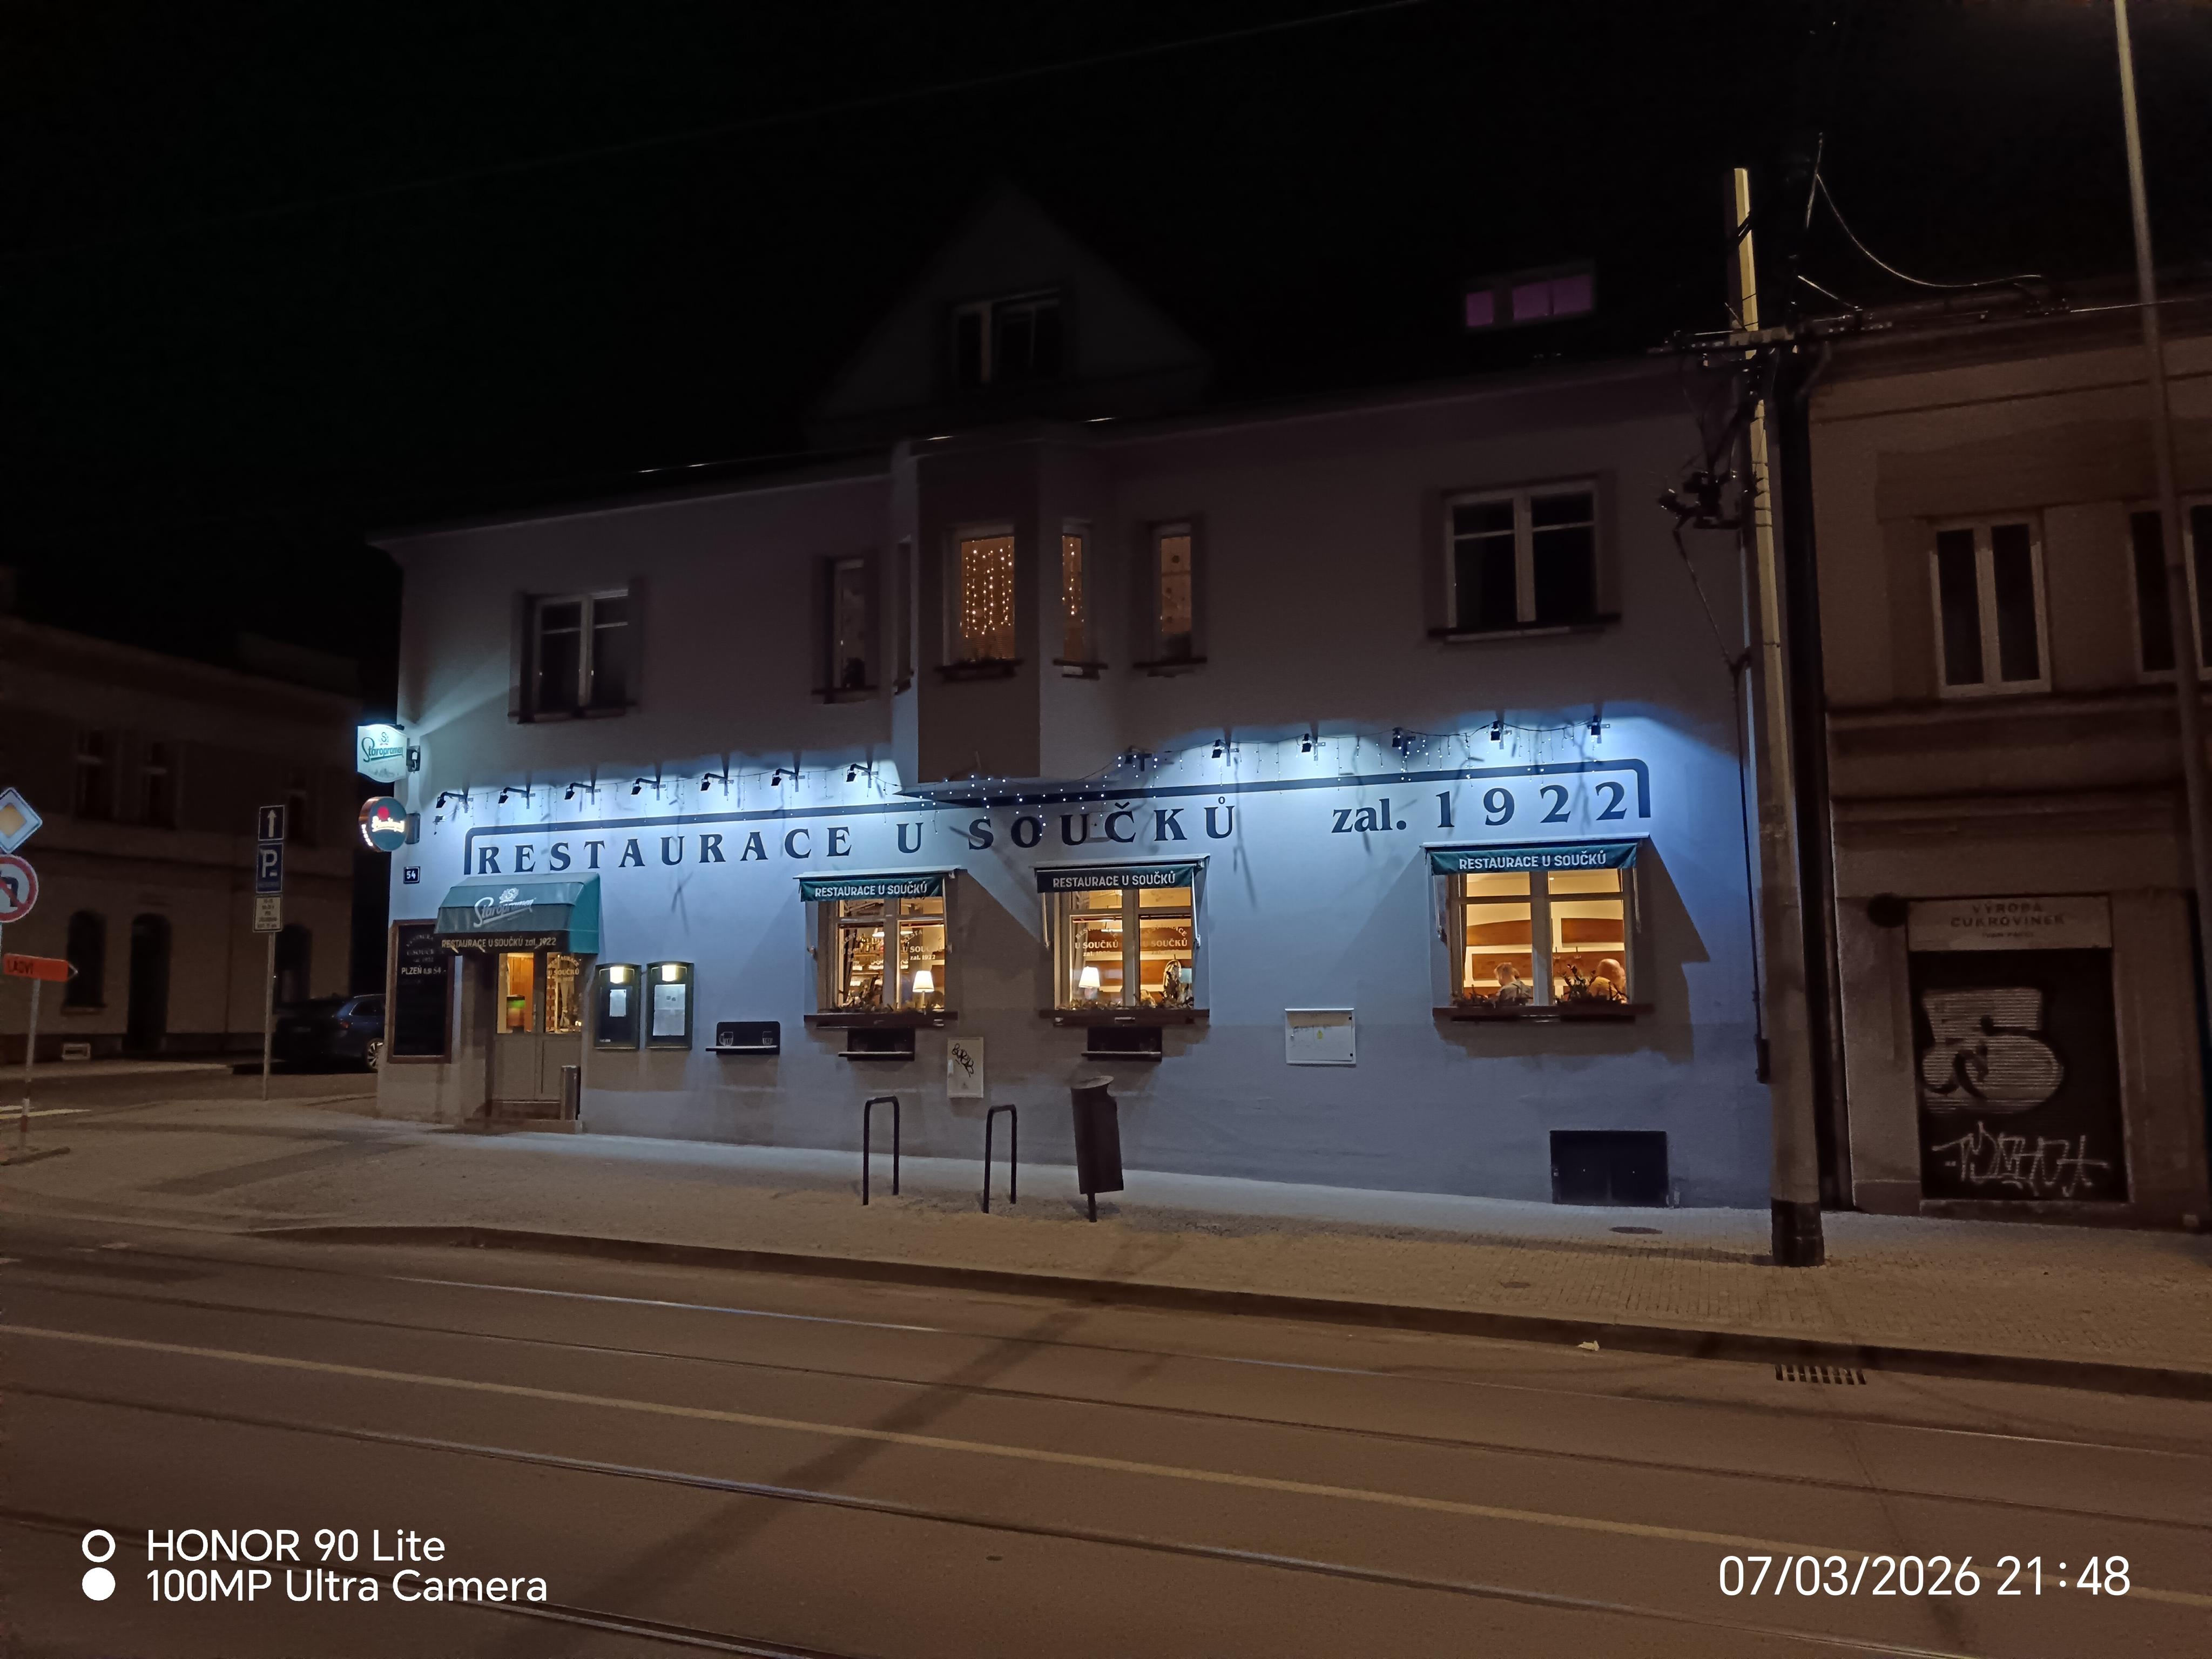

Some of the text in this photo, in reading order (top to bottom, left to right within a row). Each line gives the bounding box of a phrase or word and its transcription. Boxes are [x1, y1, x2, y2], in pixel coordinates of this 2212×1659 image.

[361, 737, 404, 763] Staropramen
[477, 781, 1628, 874] RESTAURACE U SOUČKŮ zal. 1922
[1459, 850, 1606, 869] RESTAURACE U SOUČKŮ
[407, 871, 416, 879] 54
[1053, 871, 1176, 887] RESTAURACE U SOUČKŮ
[815, 881, 927, 897] RESTAURACE U SOUČKŮ
[474, 897, 536, 928] Staropramen
[442, 939, 486, 948] RESTAURACE
[495, 936, 523, 947] SOUČKŮ
[1083, 940, 1118, 949] SOUČKŮ
[1151, 938, 1188, 947] SOUČKŮ
[401, 965, 422, 975] PLZEŇ
